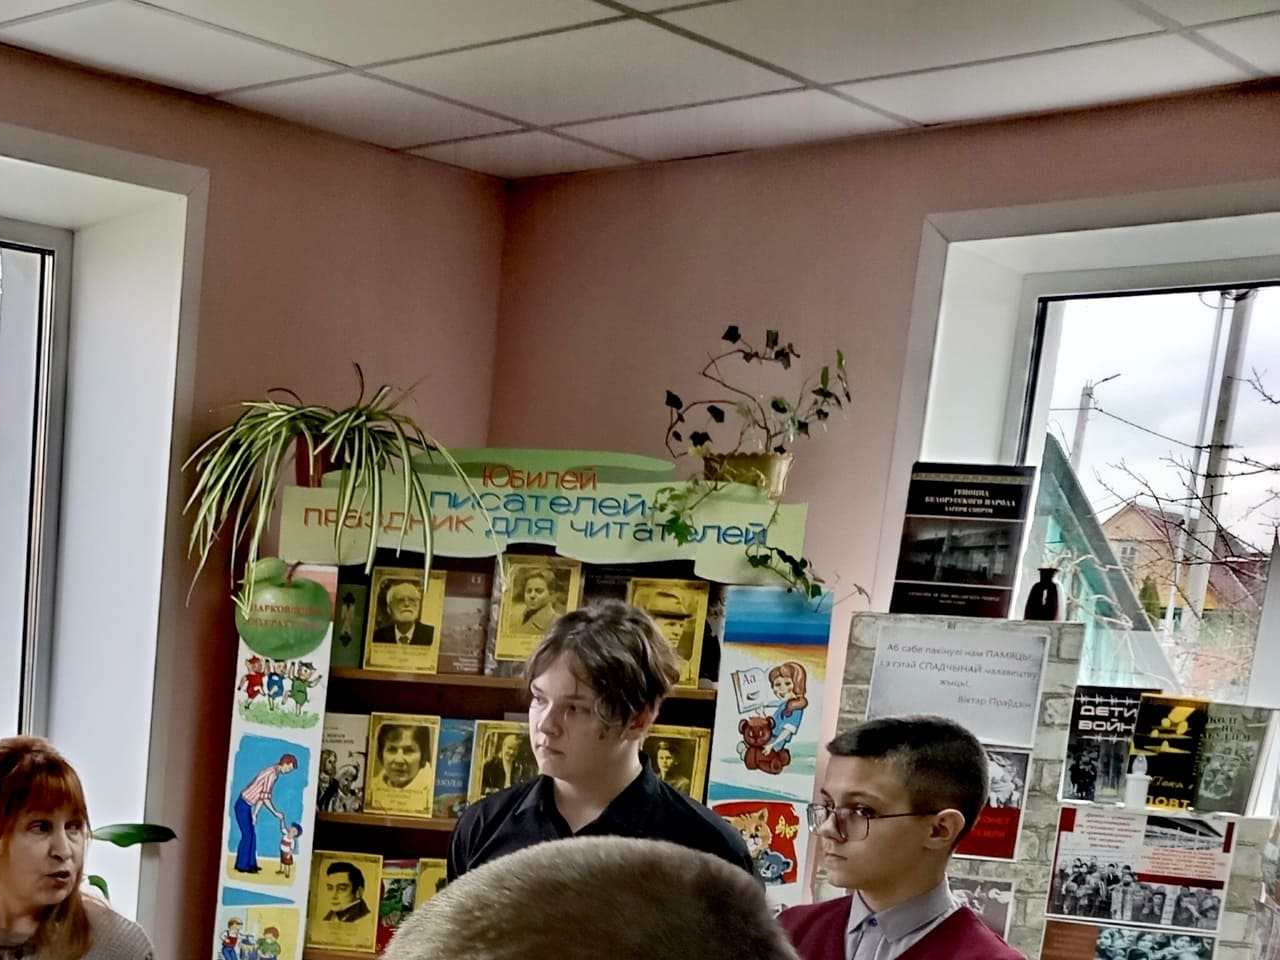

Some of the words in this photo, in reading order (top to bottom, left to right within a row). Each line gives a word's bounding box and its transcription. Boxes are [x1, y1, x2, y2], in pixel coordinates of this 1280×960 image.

[482, 465, 597, 491] Юбилей
[485, 516, 554, 539] для
[1080, 705, 1137, 718] ДЕТИ
